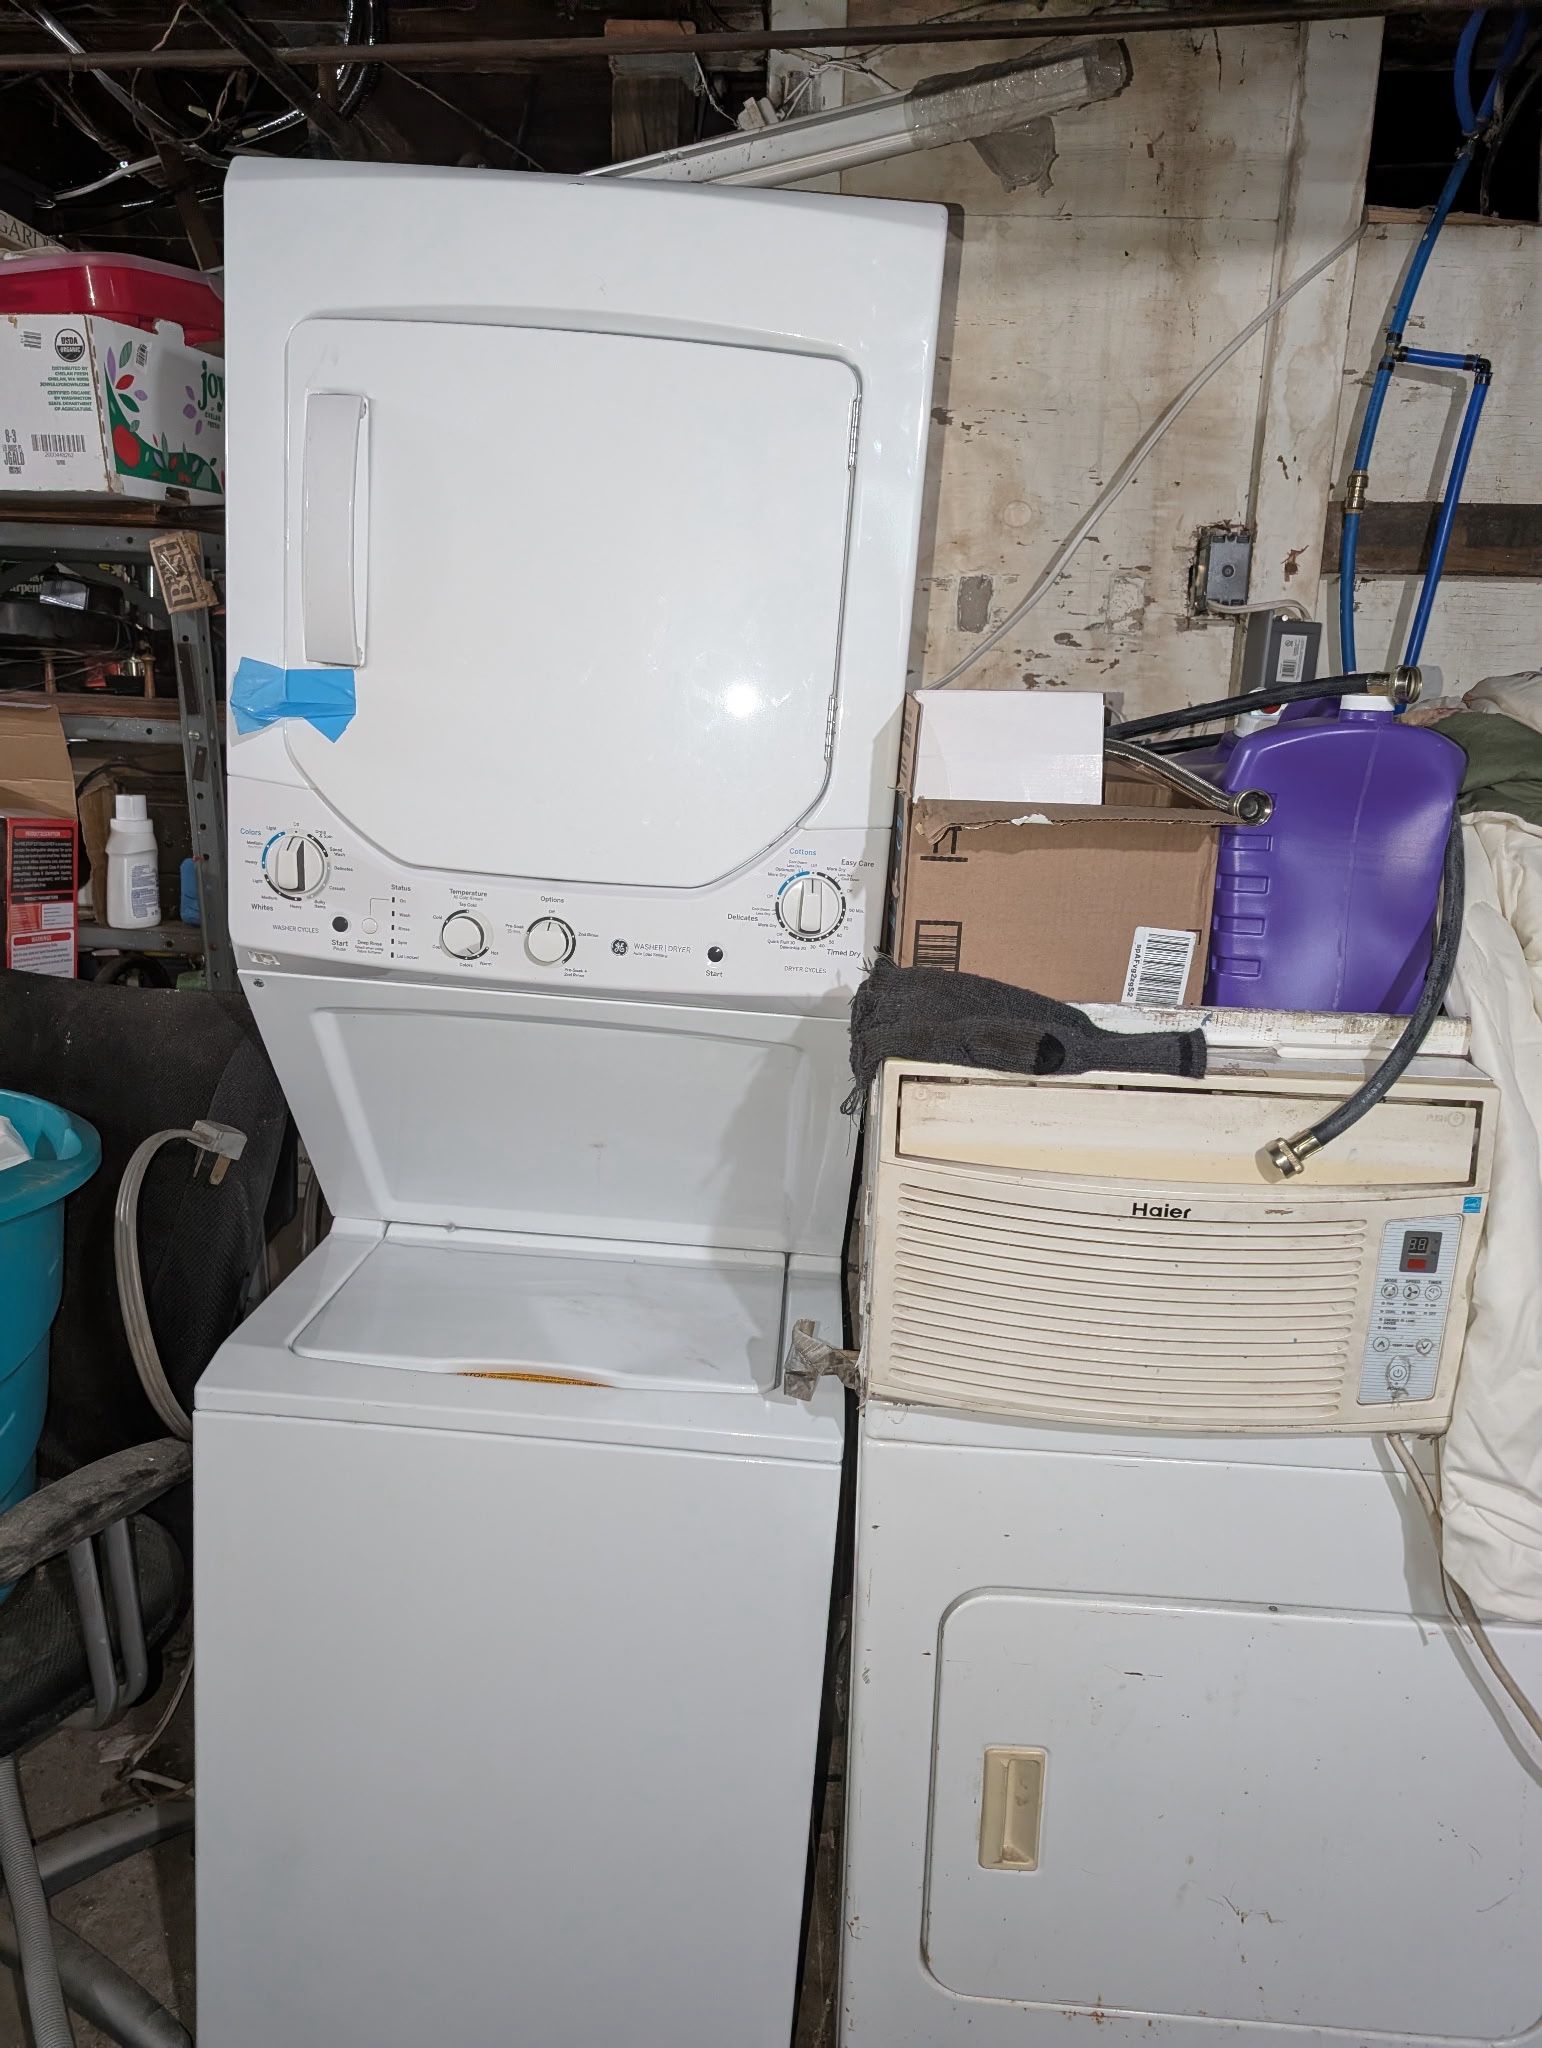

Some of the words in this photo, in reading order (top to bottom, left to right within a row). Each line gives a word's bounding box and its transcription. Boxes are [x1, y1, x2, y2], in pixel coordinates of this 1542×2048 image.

[240, 828, 262, 836] Colors
[790, 848, 816, 856] Cottons
[841, 858, 857, 868] Easy
[391, 884, 412, 892] Status
[448, 888, 488, 898] Temperature
[540, 896, 565, 904] Options
[251, 904, 274, 912] Whites
[728, 914, 758, 922] Delicates
[272, 924, 296, 932] WASHER
[849, 950, 861, 958] Dry
[706, 970, 722, 978] Start
[1132, 1202, 1192, 1218] Haier
